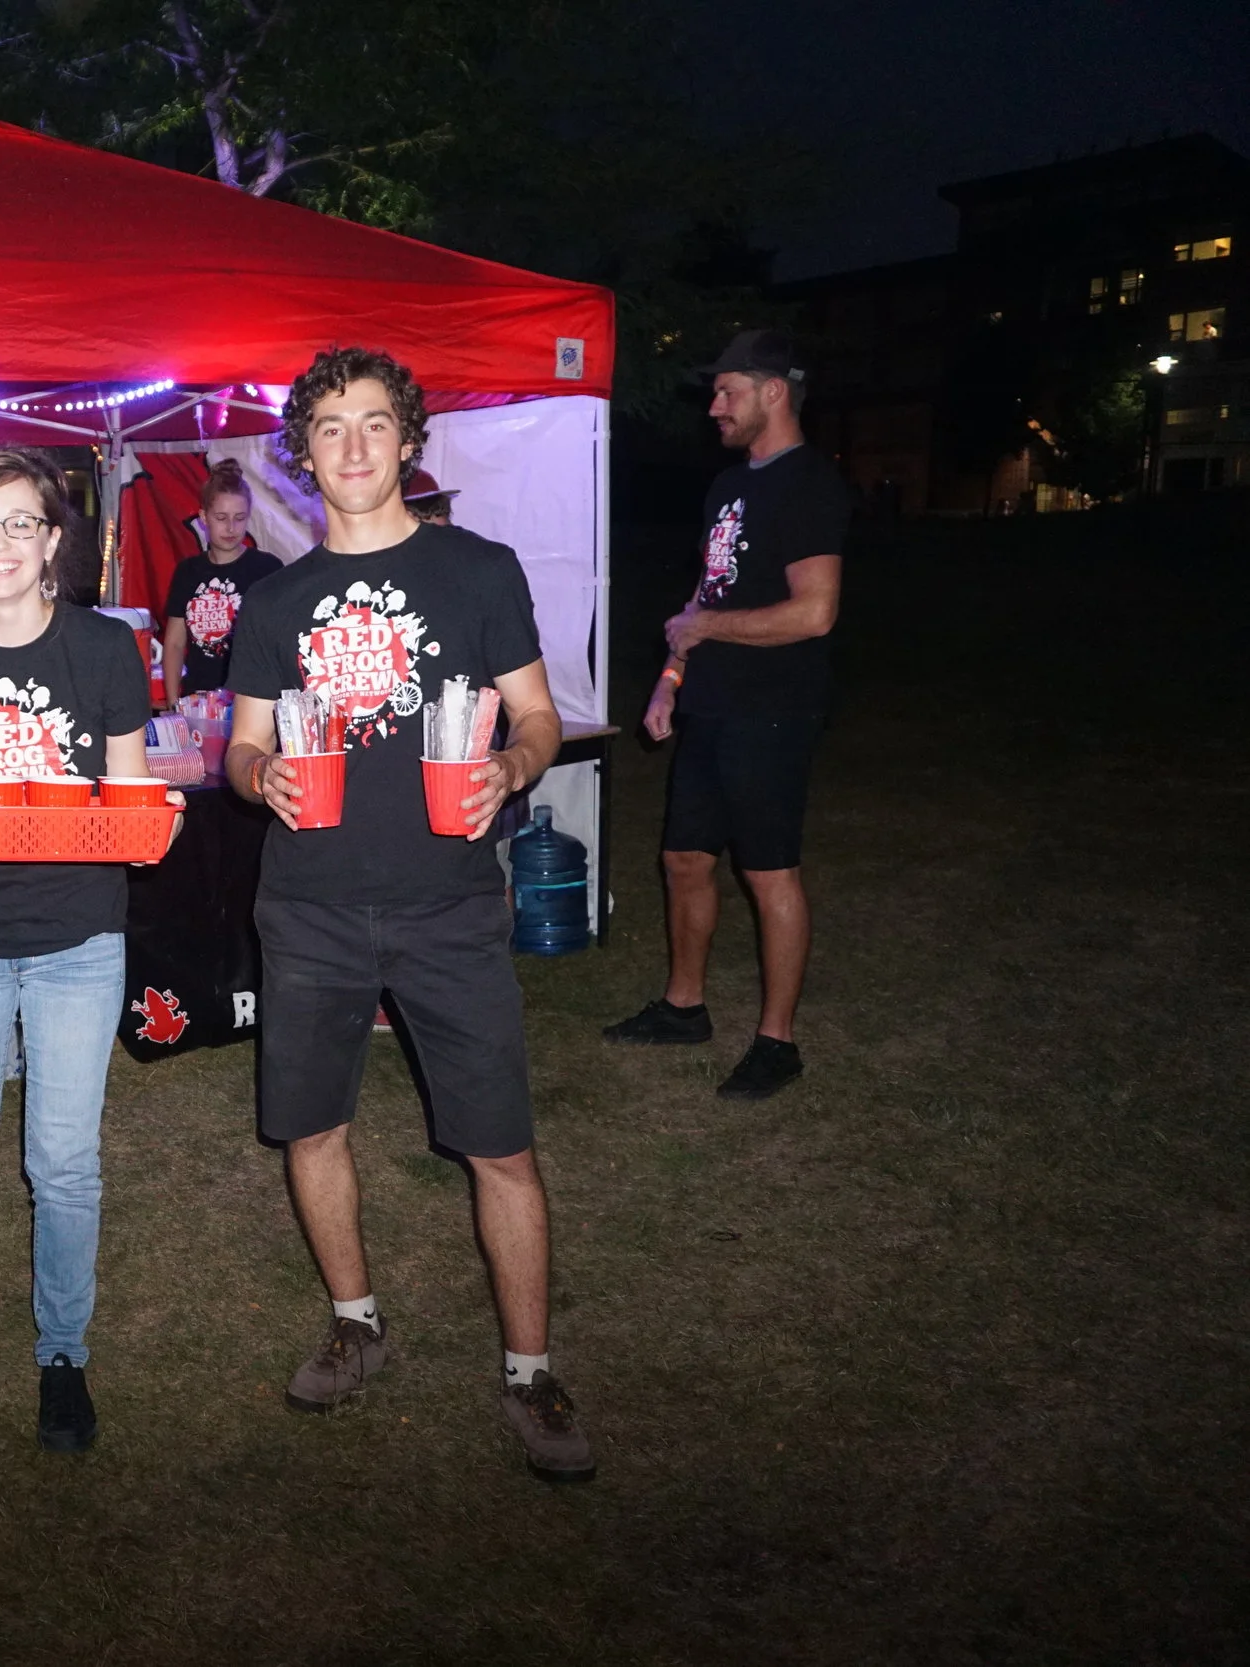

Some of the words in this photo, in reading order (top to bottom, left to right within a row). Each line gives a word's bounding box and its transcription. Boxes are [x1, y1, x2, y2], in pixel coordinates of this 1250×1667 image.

[194, 599, 229, 612] RED
[194, 610, 228, 622] FROG
[195, 620, 228, 631] CREW
[322, 624, 393, 657] RED
[324, 650, 393, 677] FROG
[329, 669, 393, 696] CREW
[233, 991, 256, 1029] R
